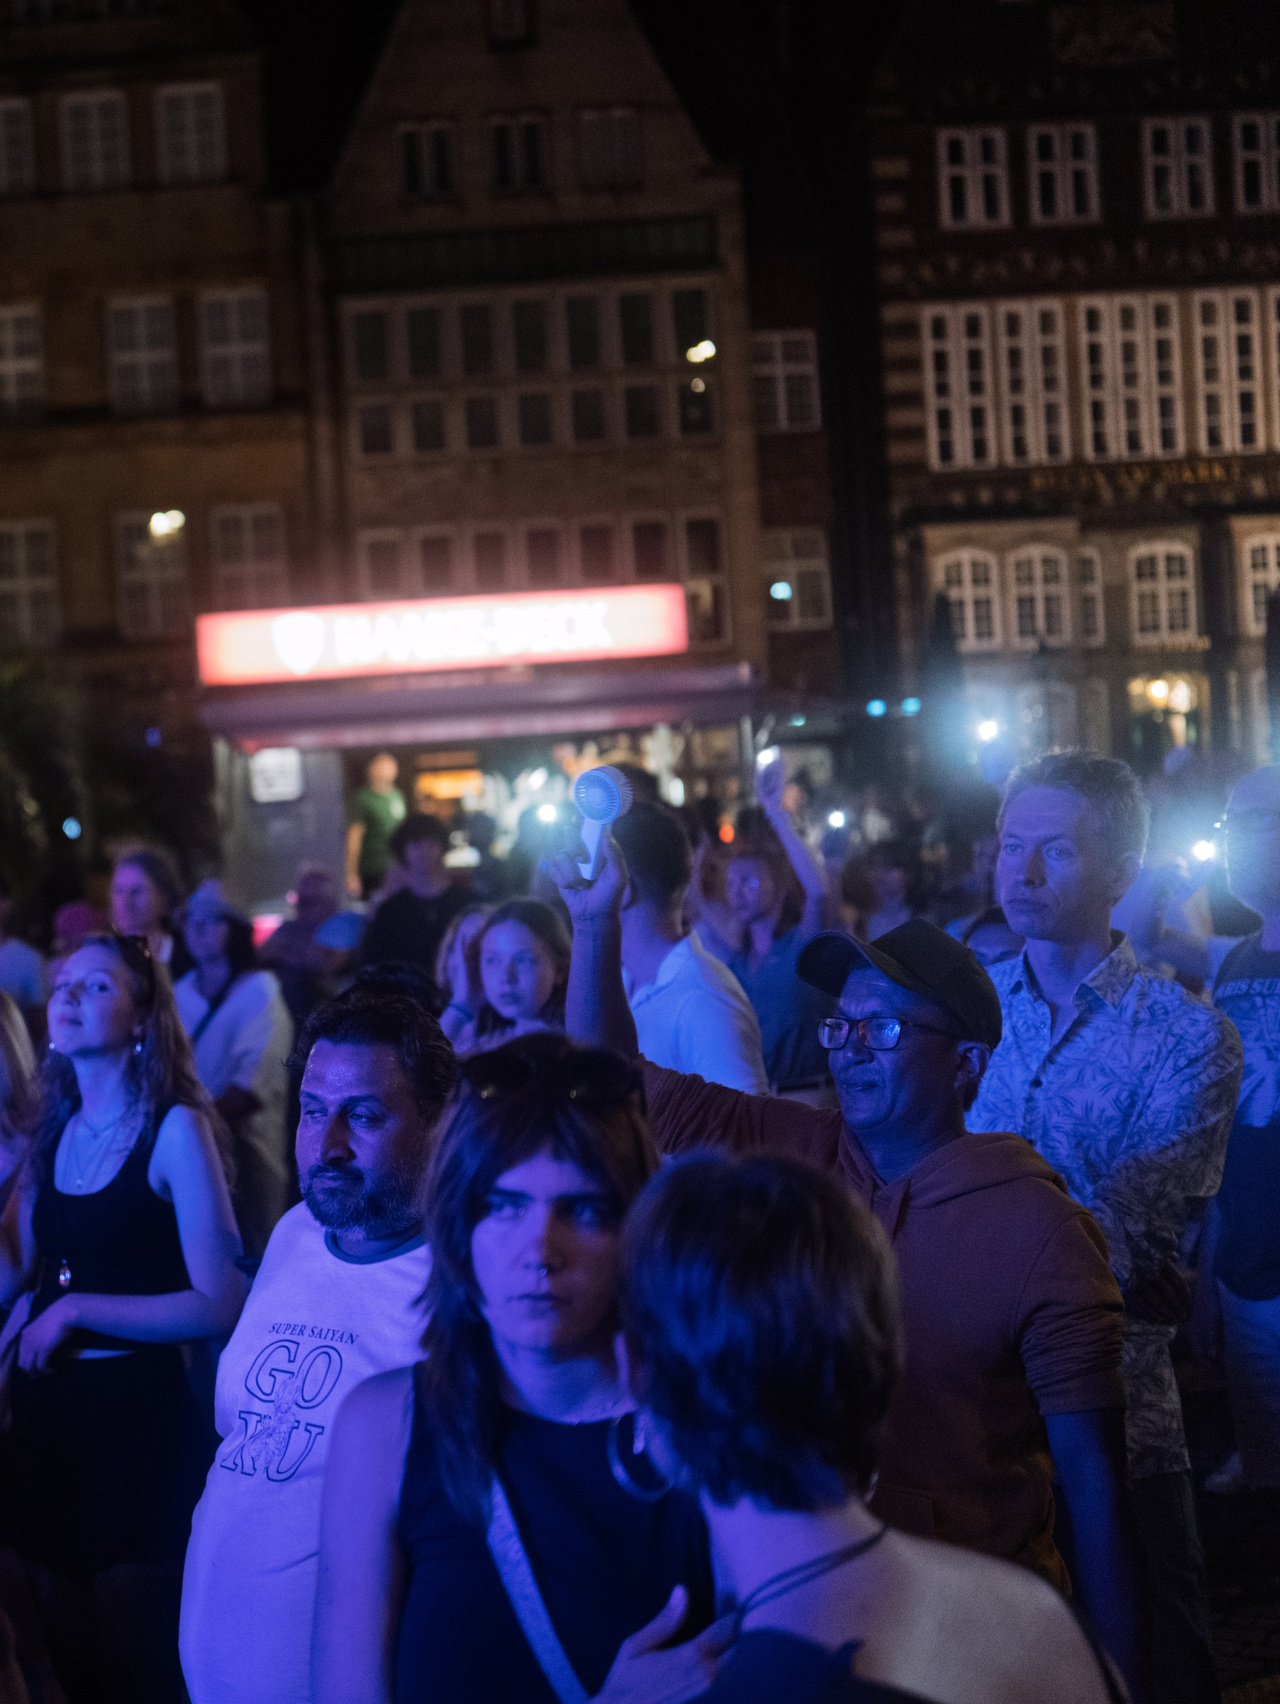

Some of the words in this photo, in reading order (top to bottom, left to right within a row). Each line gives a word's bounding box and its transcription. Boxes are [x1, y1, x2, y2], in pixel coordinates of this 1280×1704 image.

[268, 1322, 307, 1337] SUPER
[308, 1325, 359, 1346] SAIYAN
[244, 1339, 343, 1410] GO
